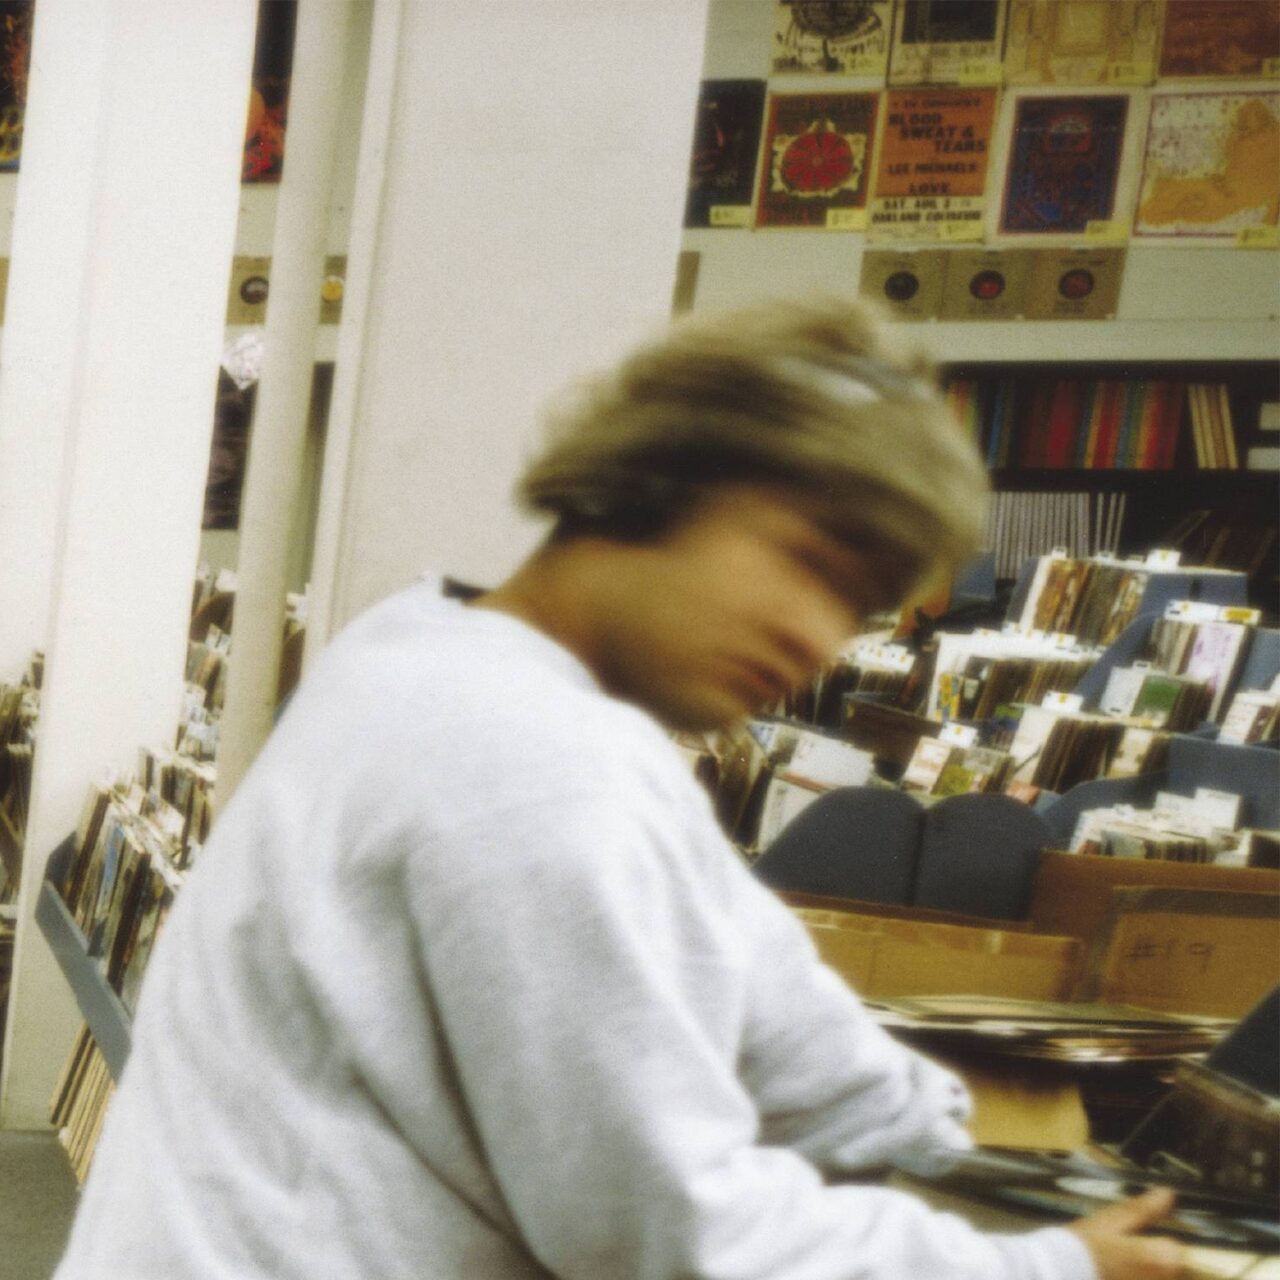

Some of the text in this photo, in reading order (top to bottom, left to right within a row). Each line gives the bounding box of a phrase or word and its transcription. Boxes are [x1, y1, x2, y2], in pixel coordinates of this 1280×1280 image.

[888, 113, 943, 126] BLOOD
[899, 126, 957, 140] SWEAT
[934, 139, 986, 153] TEARS
